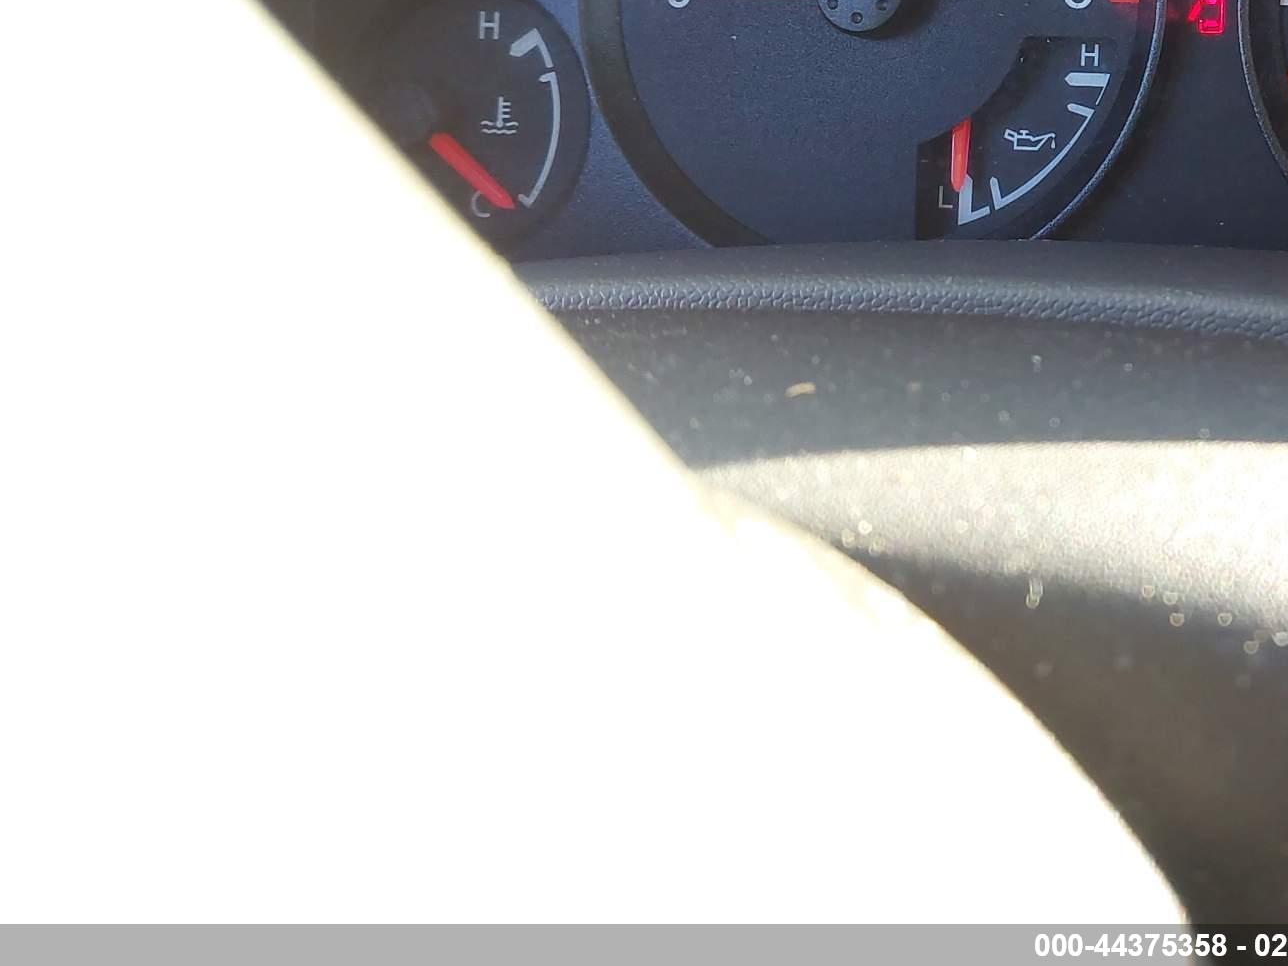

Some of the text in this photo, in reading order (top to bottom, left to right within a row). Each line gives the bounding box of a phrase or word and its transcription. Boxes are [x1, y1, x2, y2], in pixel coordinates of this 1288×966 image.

[479, 12, 499, 40] H
[1080, 45, 1099, 66] H
[938, 185, 953, 208] L
